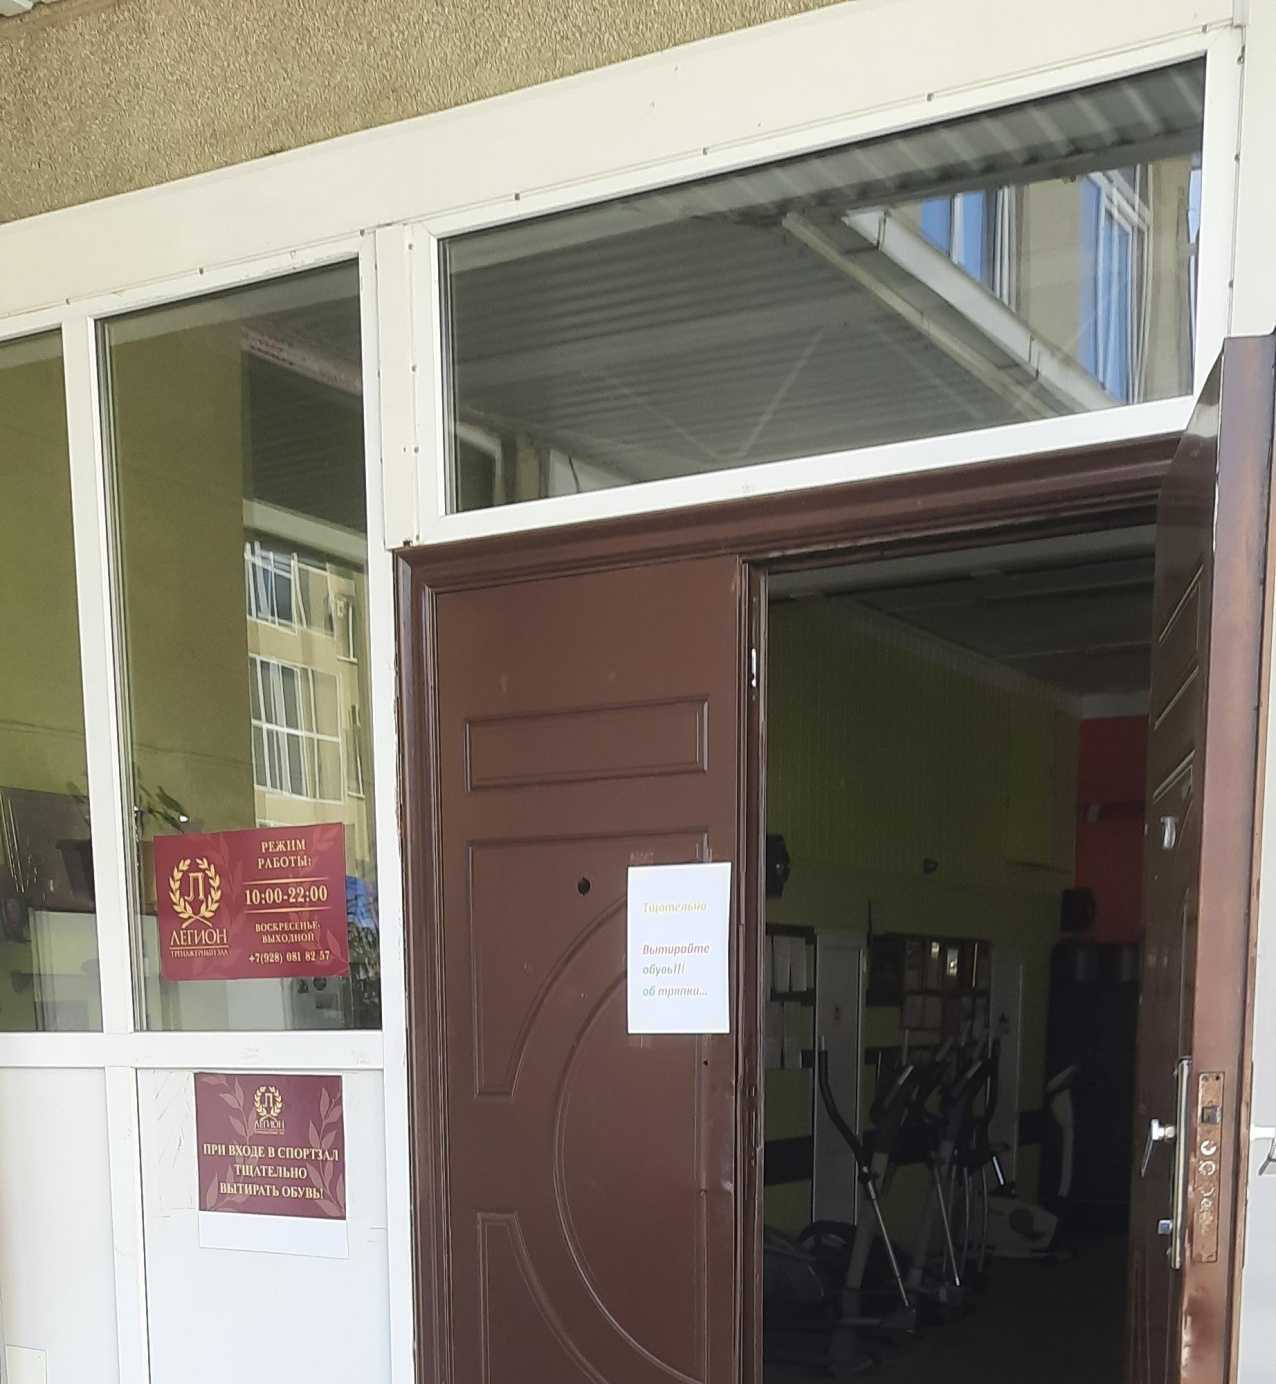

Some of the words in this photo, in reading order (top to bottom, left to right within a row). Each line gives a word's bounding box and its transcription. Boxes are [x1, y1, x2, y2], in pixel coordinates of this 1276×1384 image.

[261, 839, 306, 854] РЕЖИМ
[257, 856, 312, 870] РАБОТЫ:
[244, 885, 328, 905] 10:00-22:00
[170, 927, 228, 946] ЛЕГИОН
[262, 931, 315, 944] ВЫХОДНОЙ
[642, 943, 710, 956] Вытирайте
[249, 951, 283, 965] +7(928)
[305, 950, 316, 961] 82
[642, 985, 656, 997] об
[255, 1119, 285, 1130] ЛЕГИОН
[203, 1143, 226, 1156] ПРИ
[228, 1144, 266, 1158] ВХОДЕ
[268, 1146, 275, 1157] В
[277, 1146, 340, 1161] СПОРТЗАЛ
[233, 1164, 307, 1179] ТЩАТЕЛЬНО
[219, 1182, 280, 1197] ВЫТИРАТЬ
[281, 1185, 323, 1200] ОБУВЬ!
